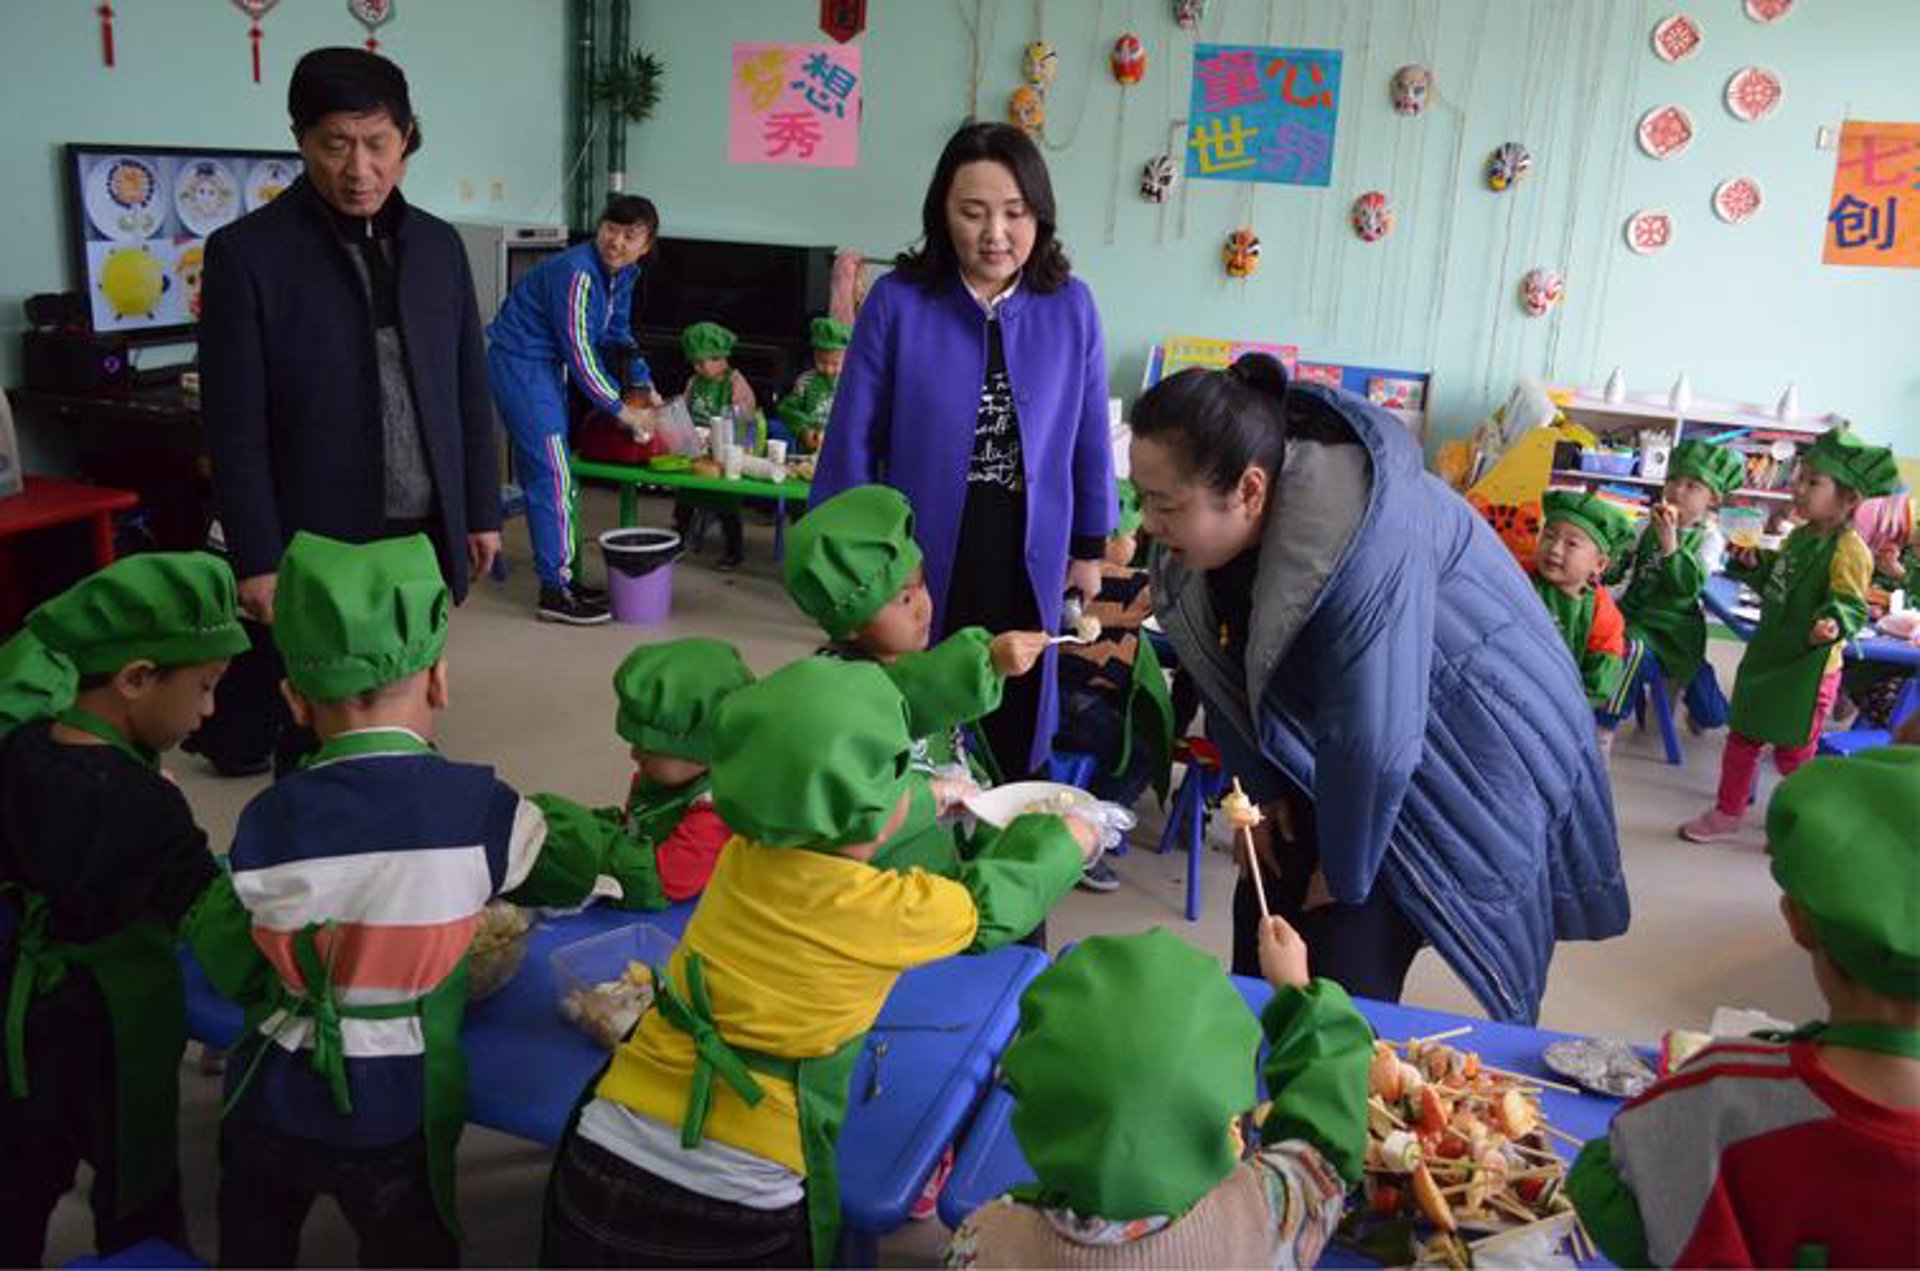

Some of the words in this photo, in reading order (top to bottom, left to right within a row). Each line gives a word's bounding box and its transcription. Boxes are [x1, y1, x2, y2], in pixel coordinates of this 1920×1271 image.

[1195, 51, 1333, 112] 童心
[763, 111, 822, 158] 秀
[1837, 134, 1920, 189] 七
[1828, 193, 1898, 250] 创
